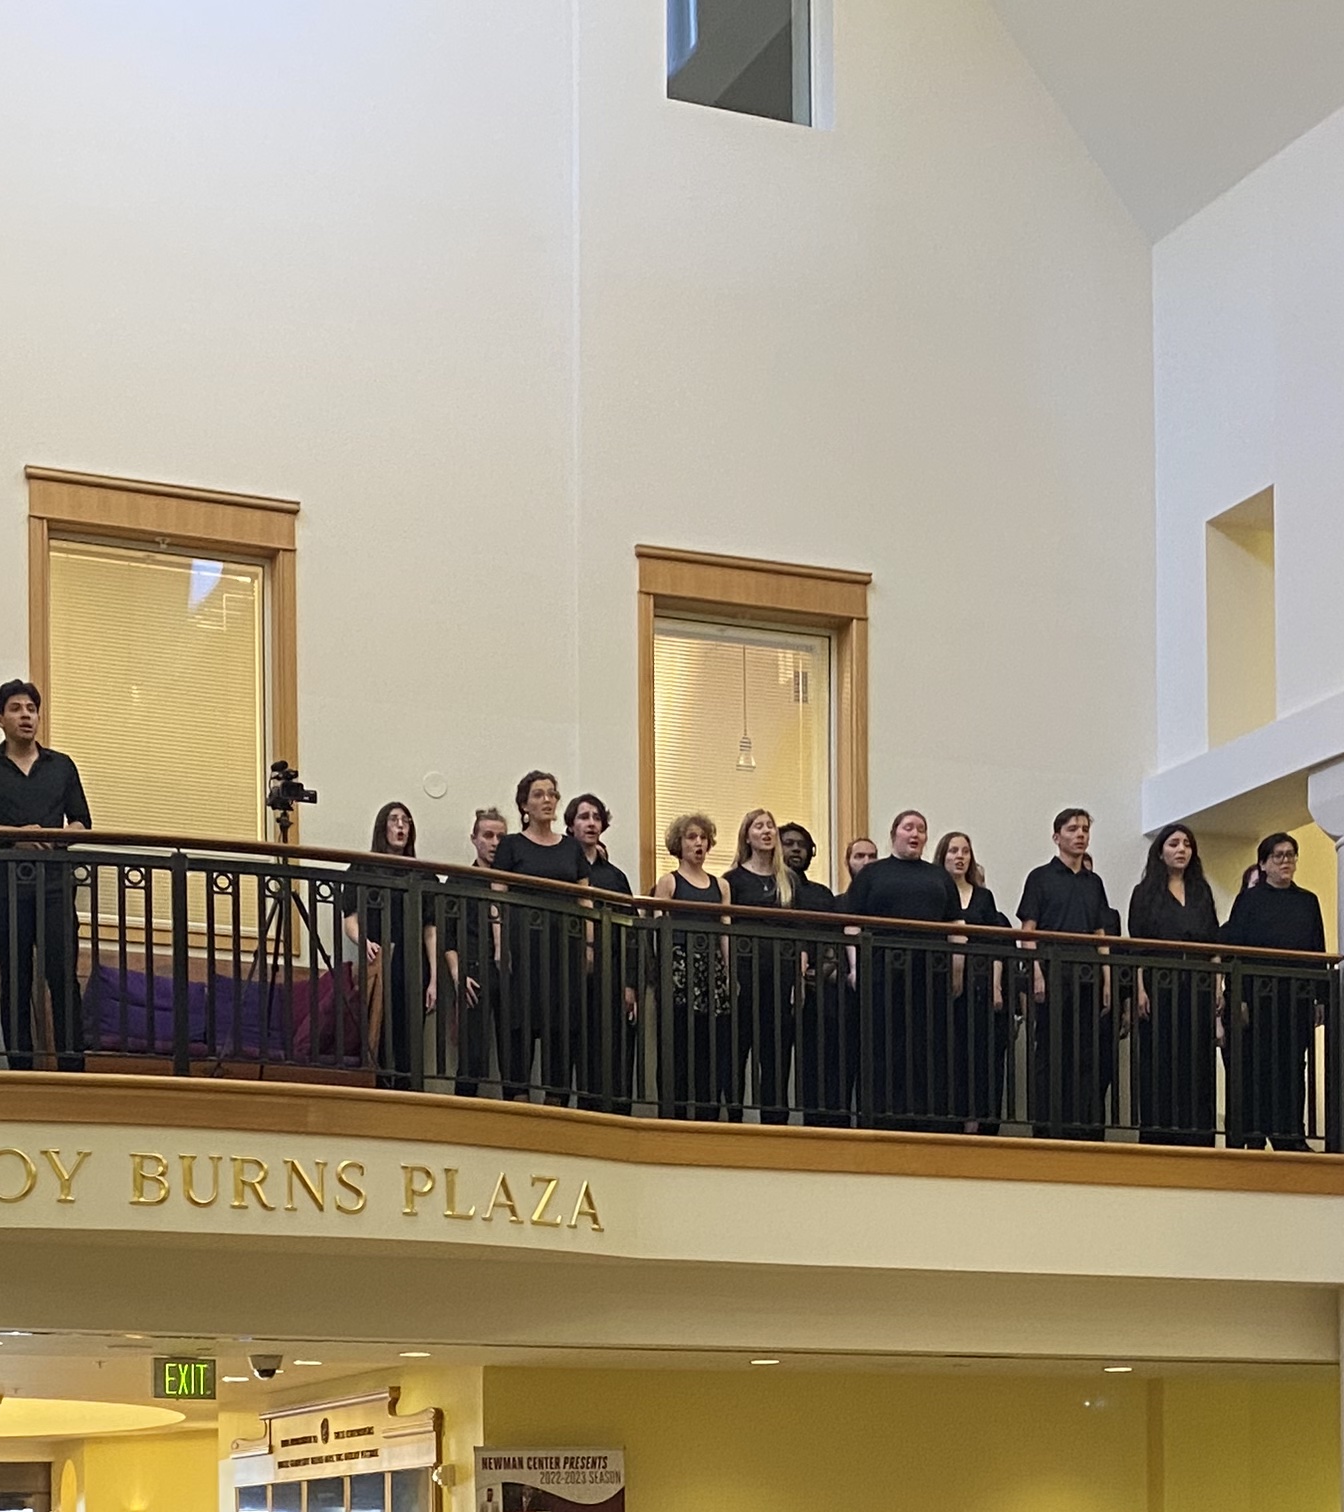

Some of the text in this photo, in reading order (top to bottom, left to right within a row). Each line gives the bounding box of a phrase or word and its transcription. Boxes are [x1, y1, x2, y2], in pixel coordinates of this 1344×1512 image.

[129, 1151, 367, 1215] BURNS
[401, 1162, 605, 1233] PLAZA
[165, 1363, 208, 1396] EXIT
[481, 1456, 608, 1470] NEWMAN CENTER PRESENTS
[588, 1471, 621, 1484] SEASON
